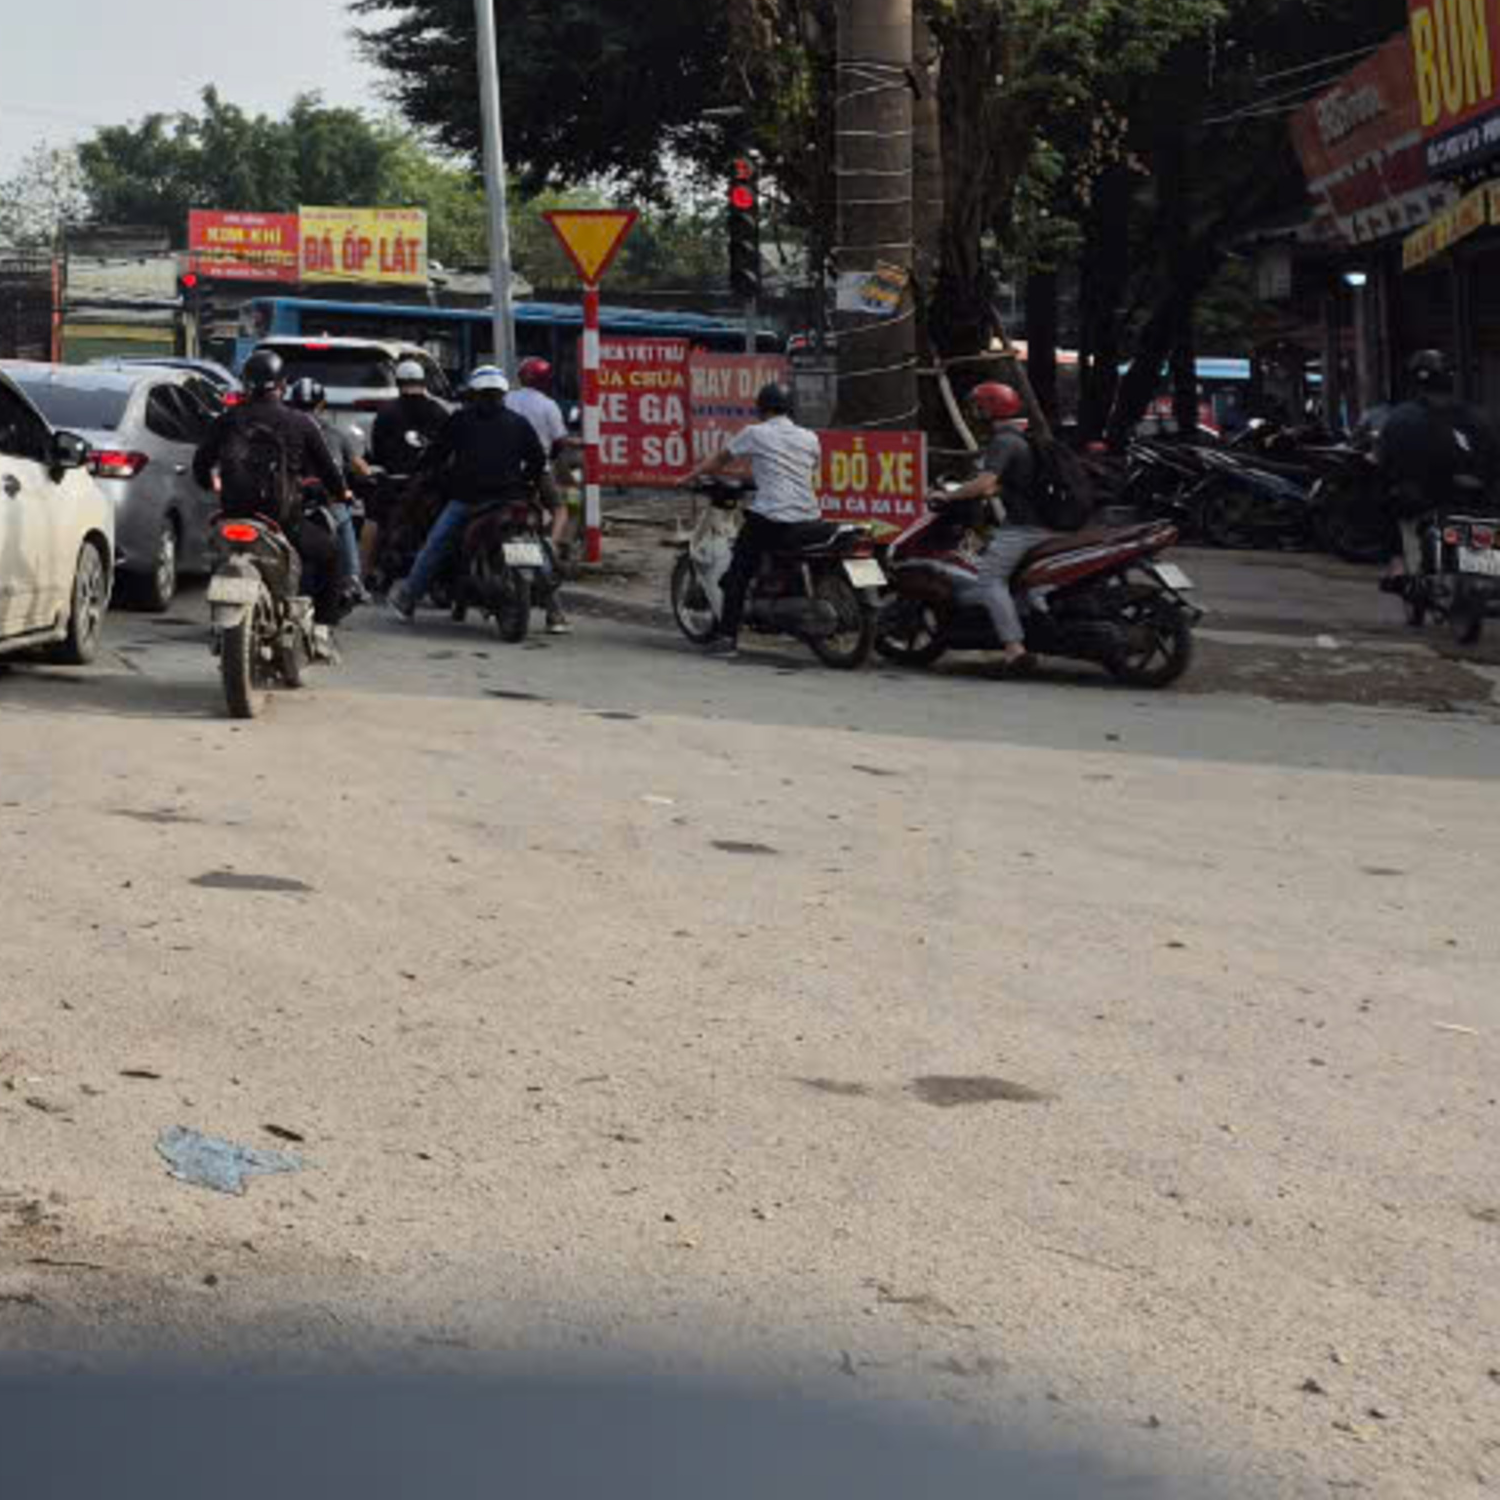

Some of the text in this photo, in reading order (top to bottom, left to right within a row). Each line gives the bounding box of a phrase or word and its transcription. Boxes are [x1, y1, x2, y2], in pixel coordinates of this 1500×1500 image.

[304, 225, 420, 275] ĐÁ ỐP LÁT
[639, 393, 684, 425] GA
[642, 430, 687, 467] SỐ
[877, 451, 913, 493] XE
